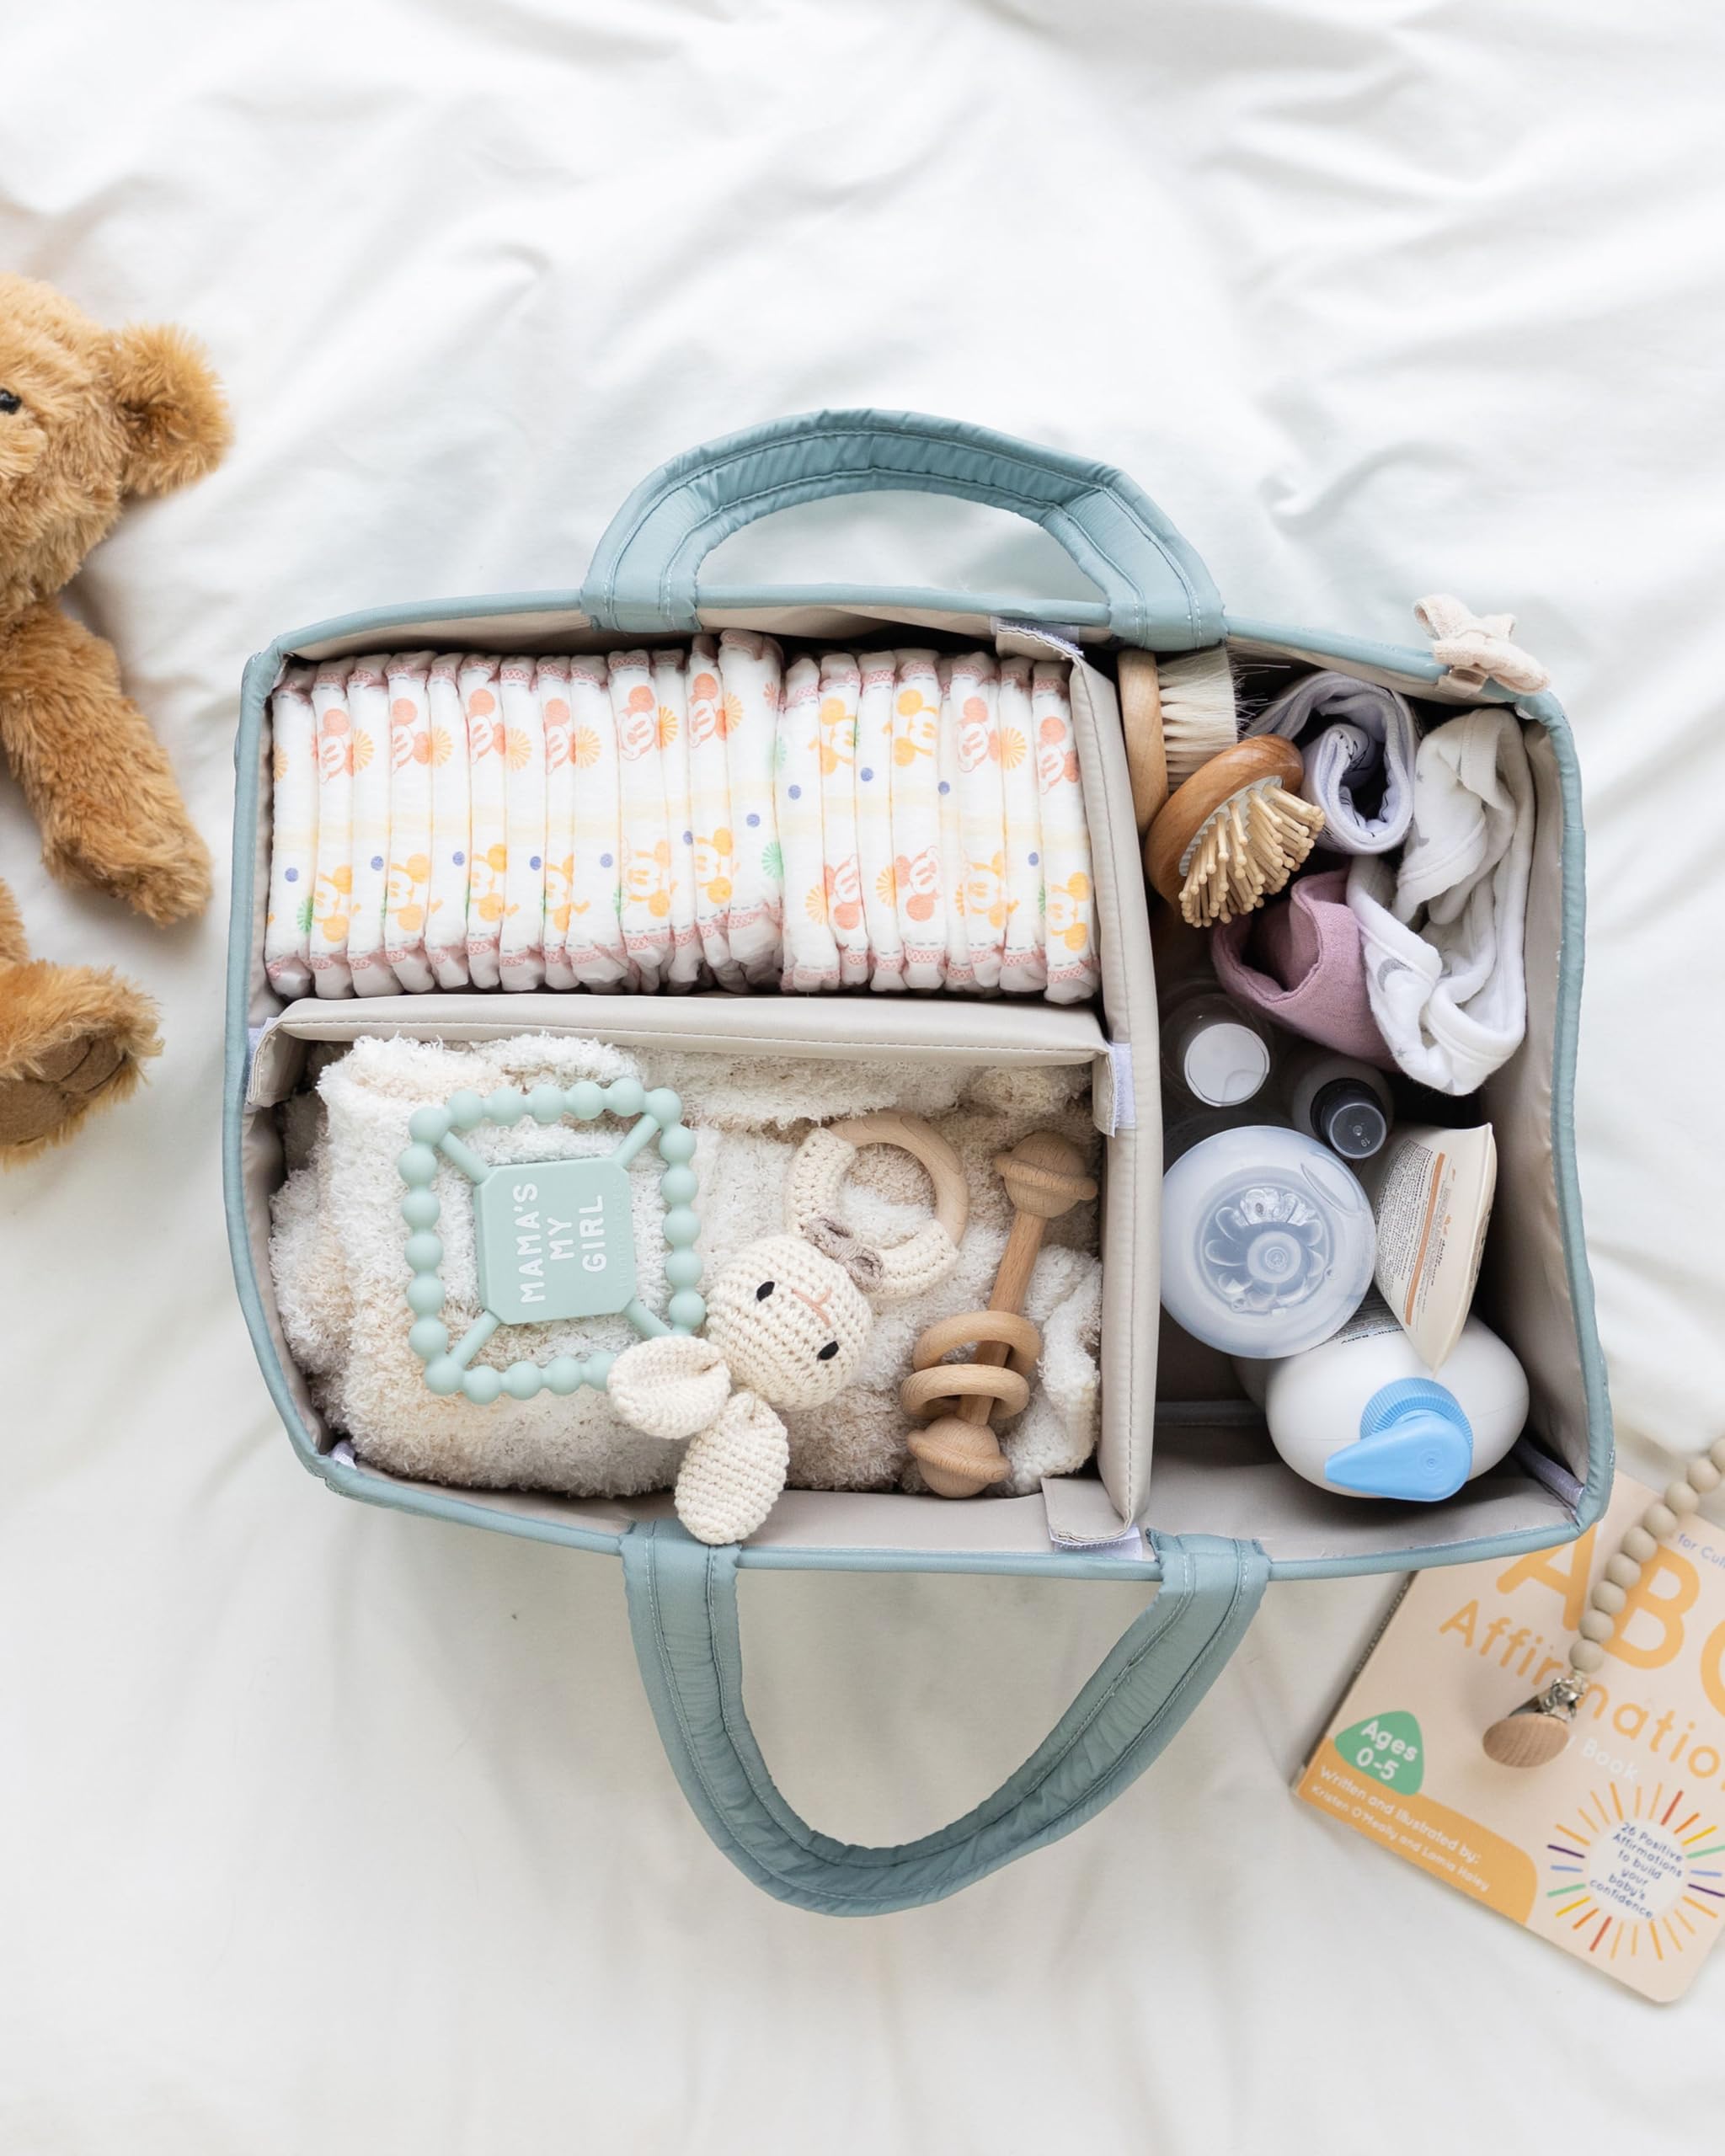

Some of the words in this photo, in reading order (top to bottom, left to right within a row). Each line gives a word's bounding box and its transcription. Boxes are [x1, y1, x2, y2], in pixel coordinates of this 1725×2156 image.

[512, 1183, 546, 1303] MAMA'S
[547, 1218, 574, 1260] MY
[579, 1195, 606, 1273] GIRL
[1678, 1533, 1698, 1550] for
[1439, 1599, 1725, 1792] Affirmatio
[1361, 1720, 1418, 1762] Ages
[1580, 1737, 1638, 1782] Book
[1356, 1747, 1400, 1780] 0-5
[1320, 1765, 1366, 1800] Written
[1368, 1796, 1395, 1815] and
[1396, 1807, 1459, 1851] Illustrated
[1459, 1843, 1481, 1865] by:
[1399, 1835, 1423, 1853] and
[1613, 1833, 1682, 1877] Affirmations
[1621, 1822, 1636, 1836] 26
[1639, 1832, 1683, 1862] Positive
[1618, 1849, 1630, 1862] to
[1633, 1858, 1662, 1880] build
[1621, 1869, 1648, 1886] your
[1589, 1879, 1653, 1919] confidence
[1609, 1873, 1645, 1900] baby's
